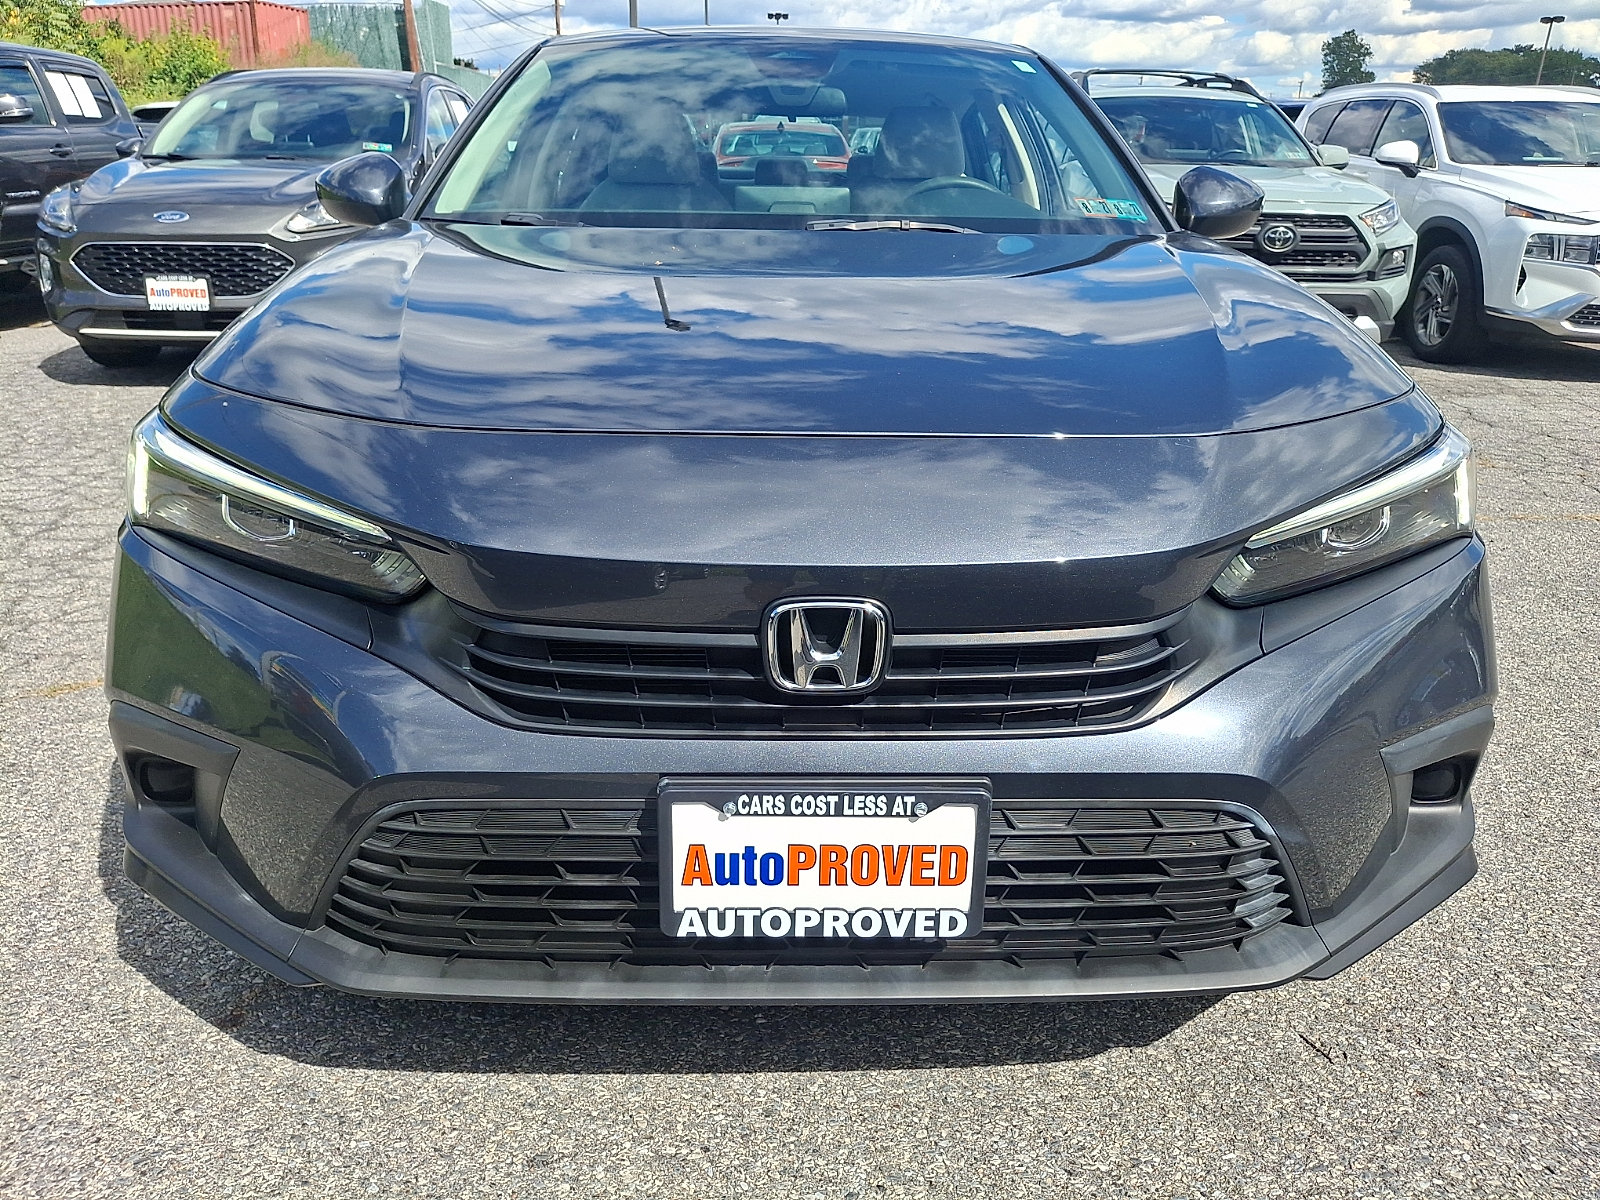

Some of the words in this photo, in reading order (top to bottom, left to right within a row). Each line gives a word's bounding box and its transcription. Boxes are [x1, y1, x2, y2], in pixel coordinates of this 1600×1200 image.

[150, 288, 207, 298] AutoPROVED
[737, 794, 786, 816] CARS
[790, 794, 840, 816] COST
[842, 794, 889, 816] LESS
[891, 795, 917, 816] AT
[681, 844, 969, 887] AutoPROVED
[676, 907, 969, 938] AUTOPROVED
